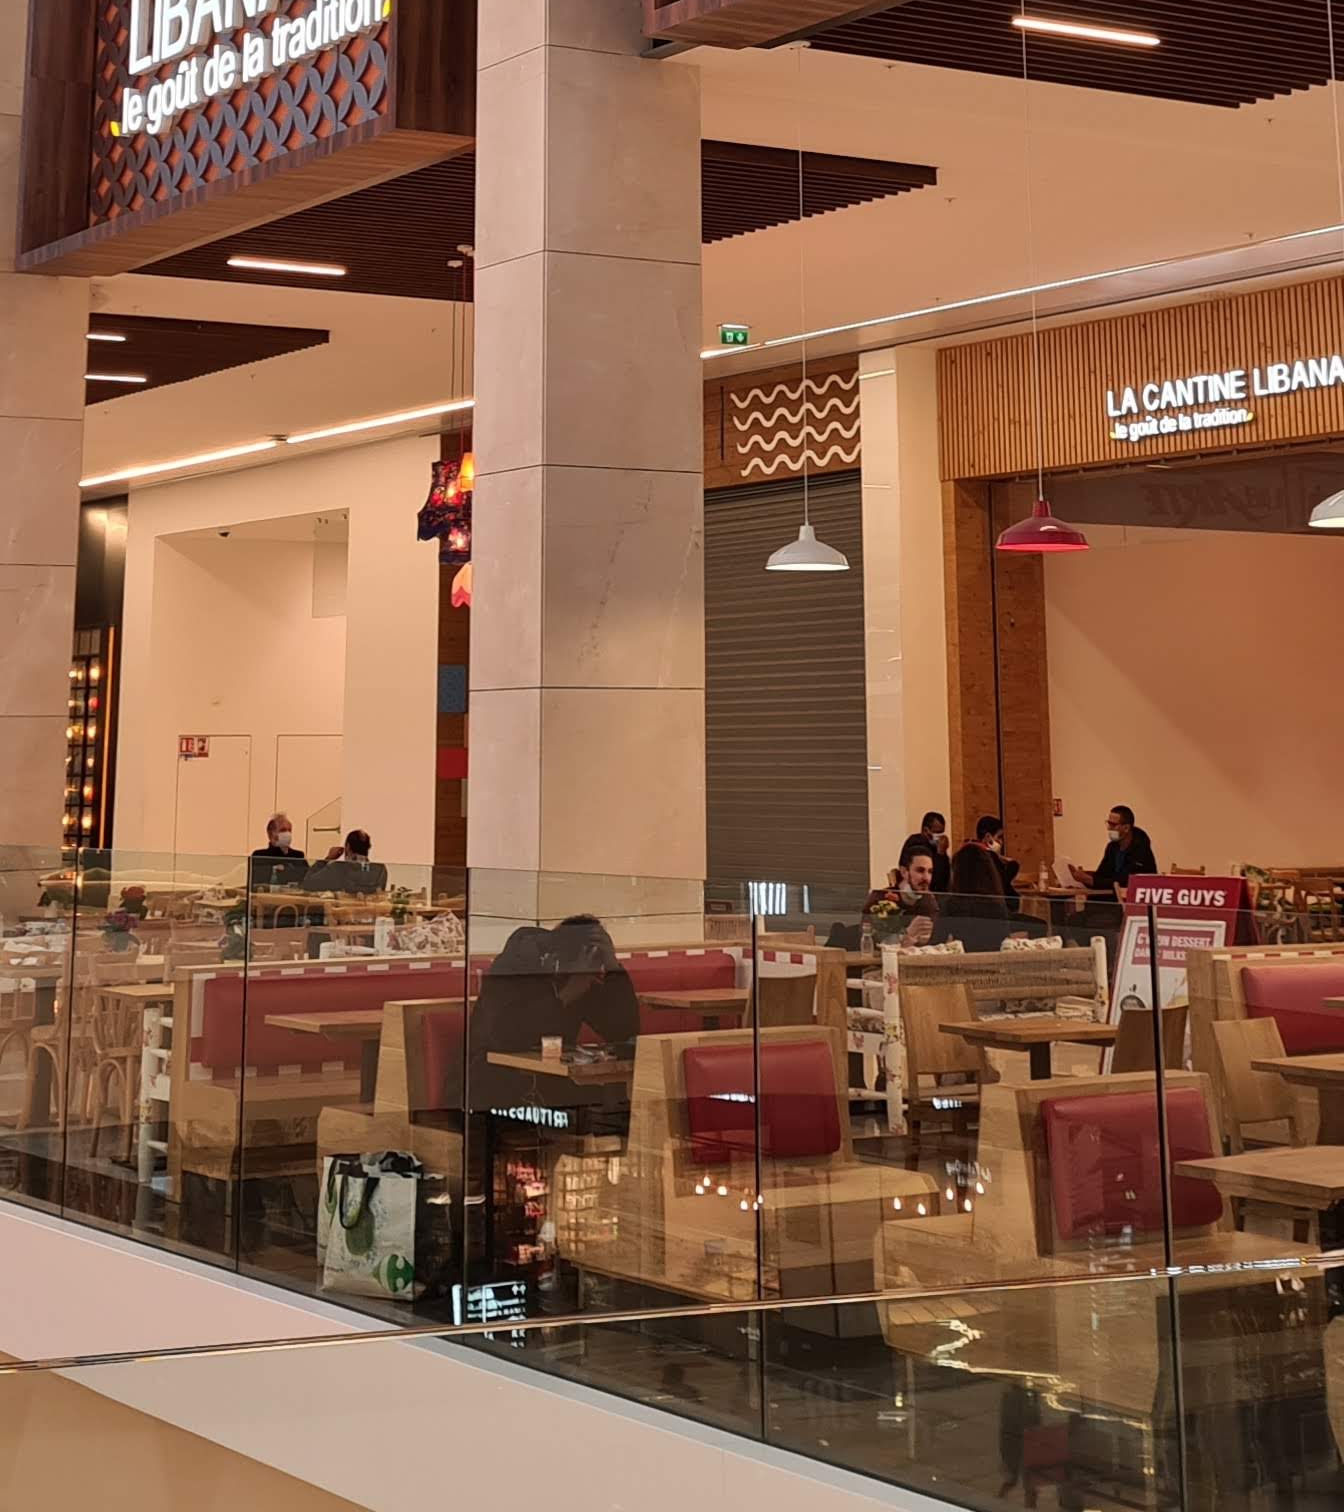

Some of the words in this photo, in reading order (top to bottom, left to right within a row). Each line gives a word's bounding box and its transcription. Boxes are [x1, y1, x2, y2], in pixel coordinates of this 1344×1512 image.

[122, 87, 145, 135] le
[147, 56, 200, 136] goût
[203, 44, 238, 100] de
[242, 32, 271, 84] la
[1106, 387, 1138, 417] LA
[1142, 370, 1247, 412] CANTINE
[1115, 421, 1127, 439] le
[1129, 415, 1159, 442] goût
[1160, 415, 1176, 434] de
[1178, 413, 1192, 431] la
[1193, 407, 1248, 429] tradition
[1135, 887, 1173, 905] FIVE
[1177, 889, 1226, 907] GUYS
